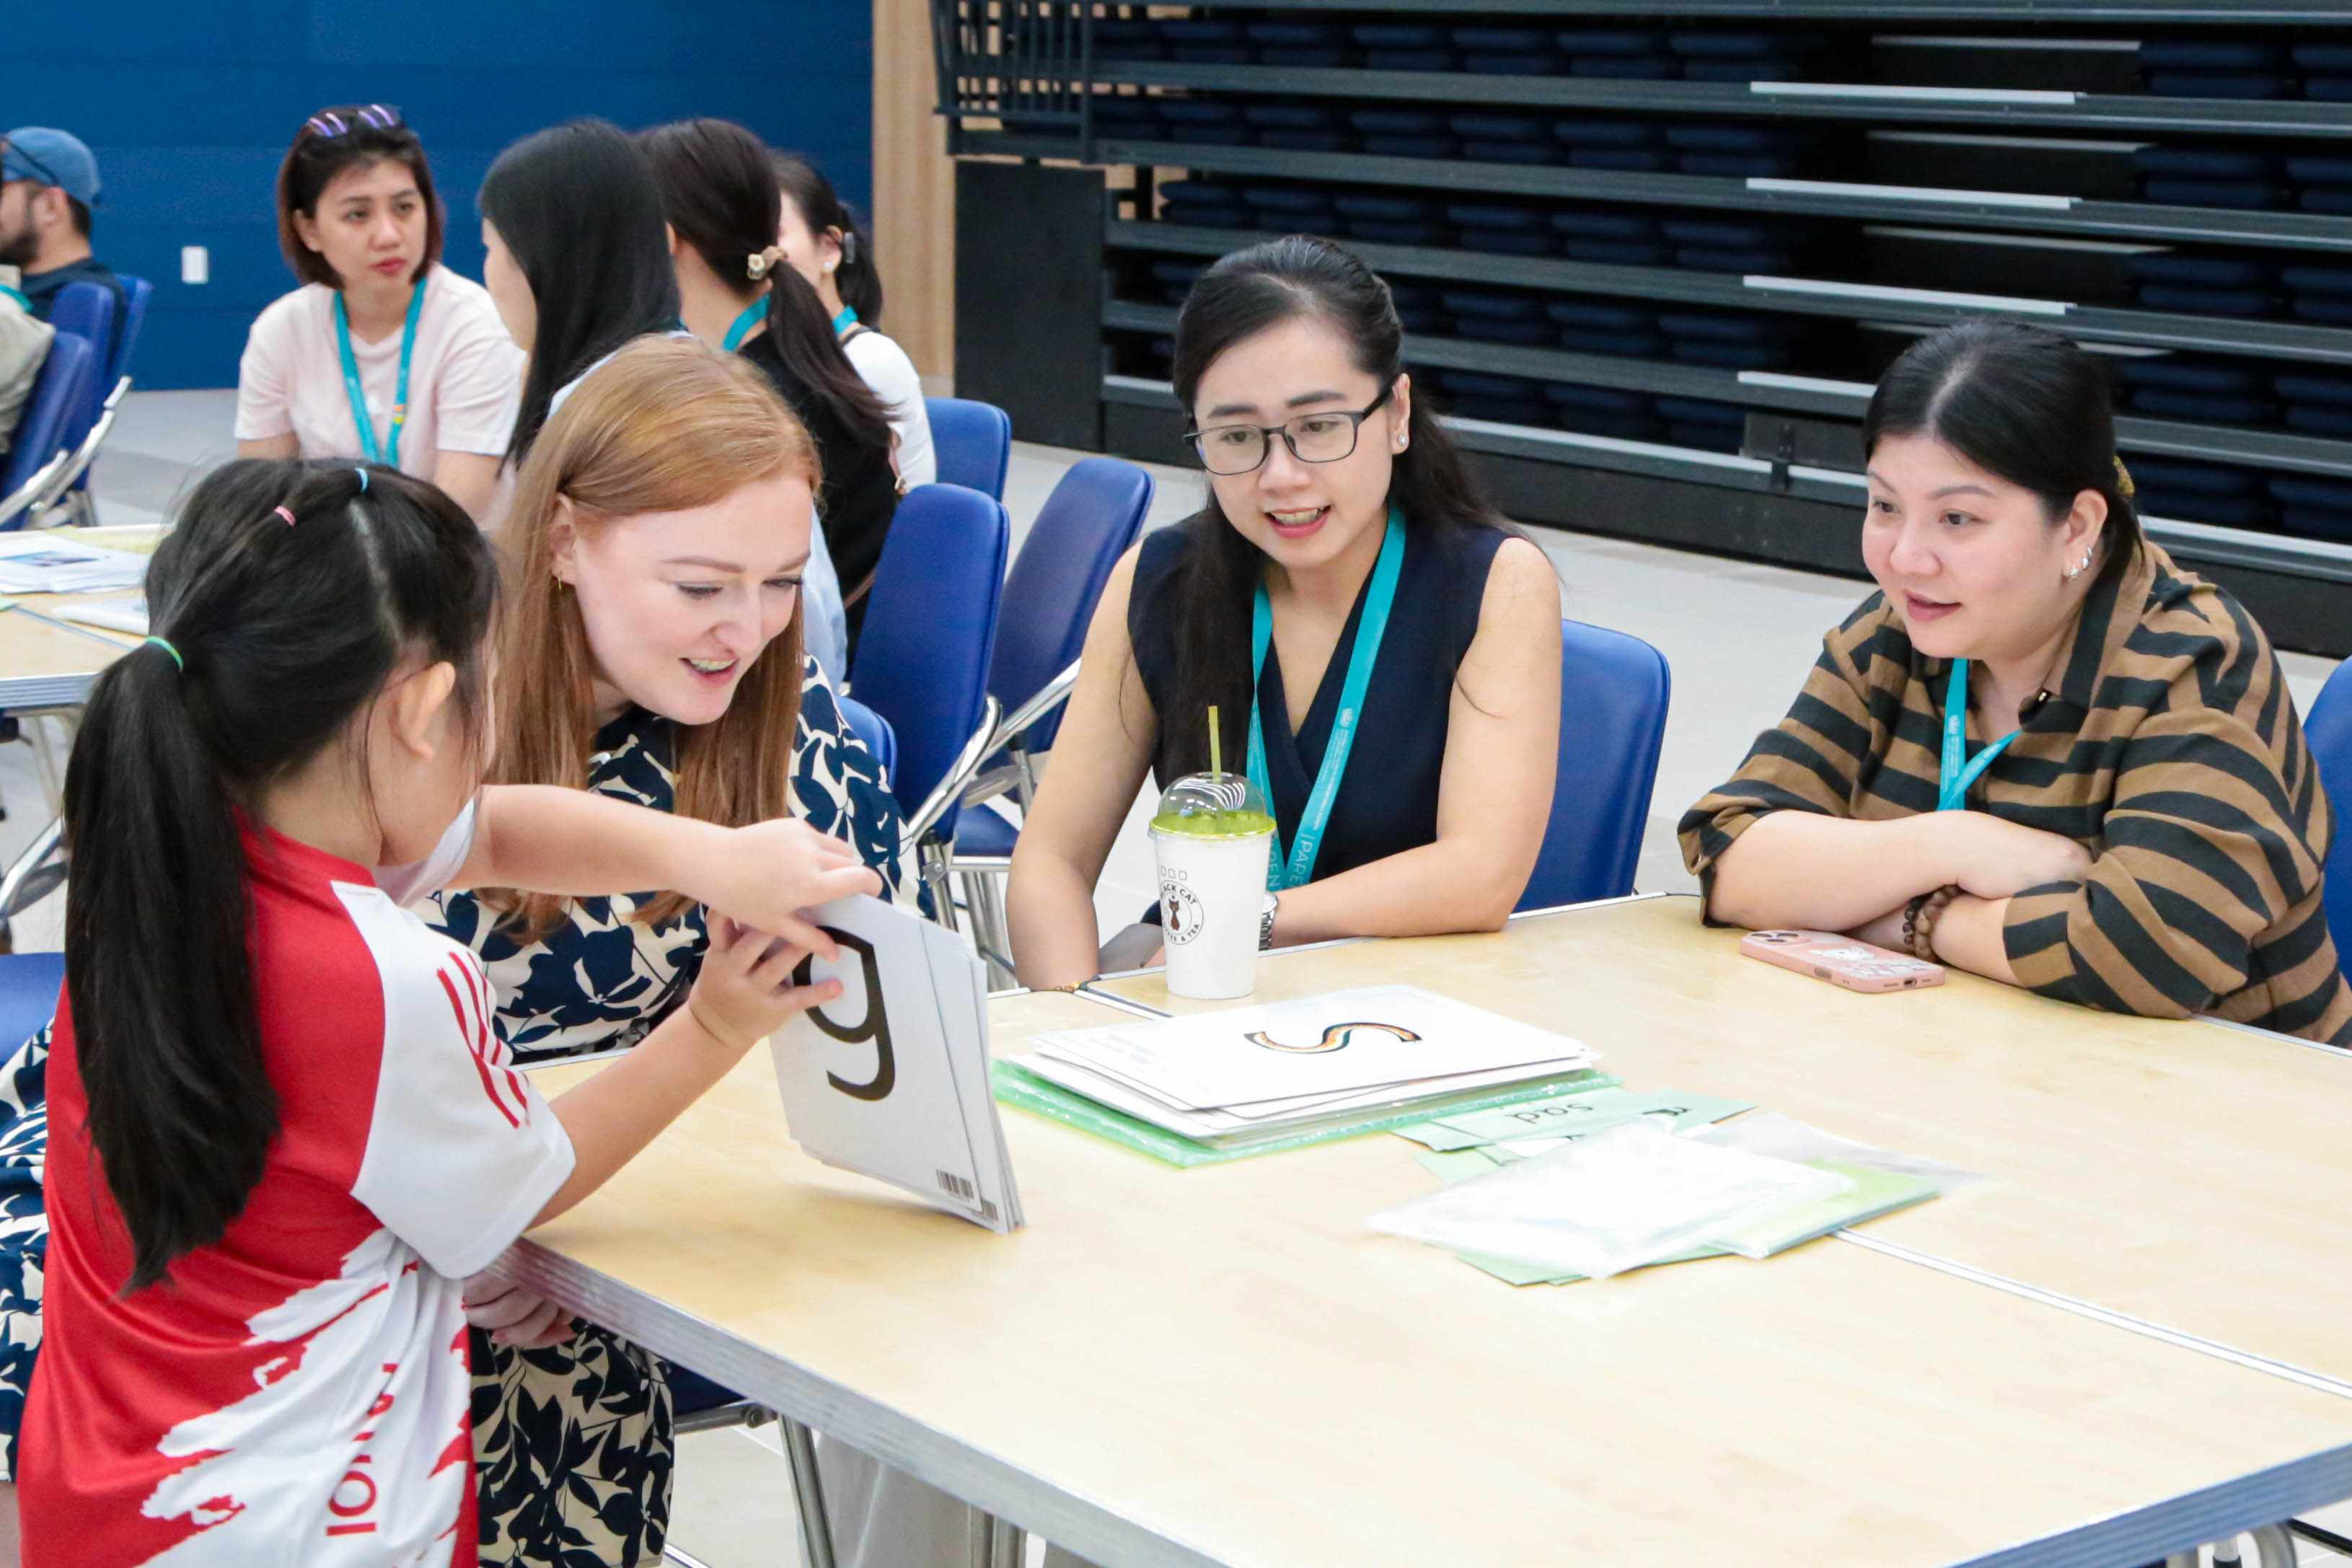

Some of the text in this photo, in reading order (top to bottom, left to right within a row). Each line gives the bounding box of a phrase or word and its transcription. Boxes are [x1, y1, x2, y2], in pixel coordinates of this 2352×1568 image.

[1289, 840, 1313, 884] PARE
[1179, 889, 1197, 904] CAT
[791, 925, 896, 1101] g
